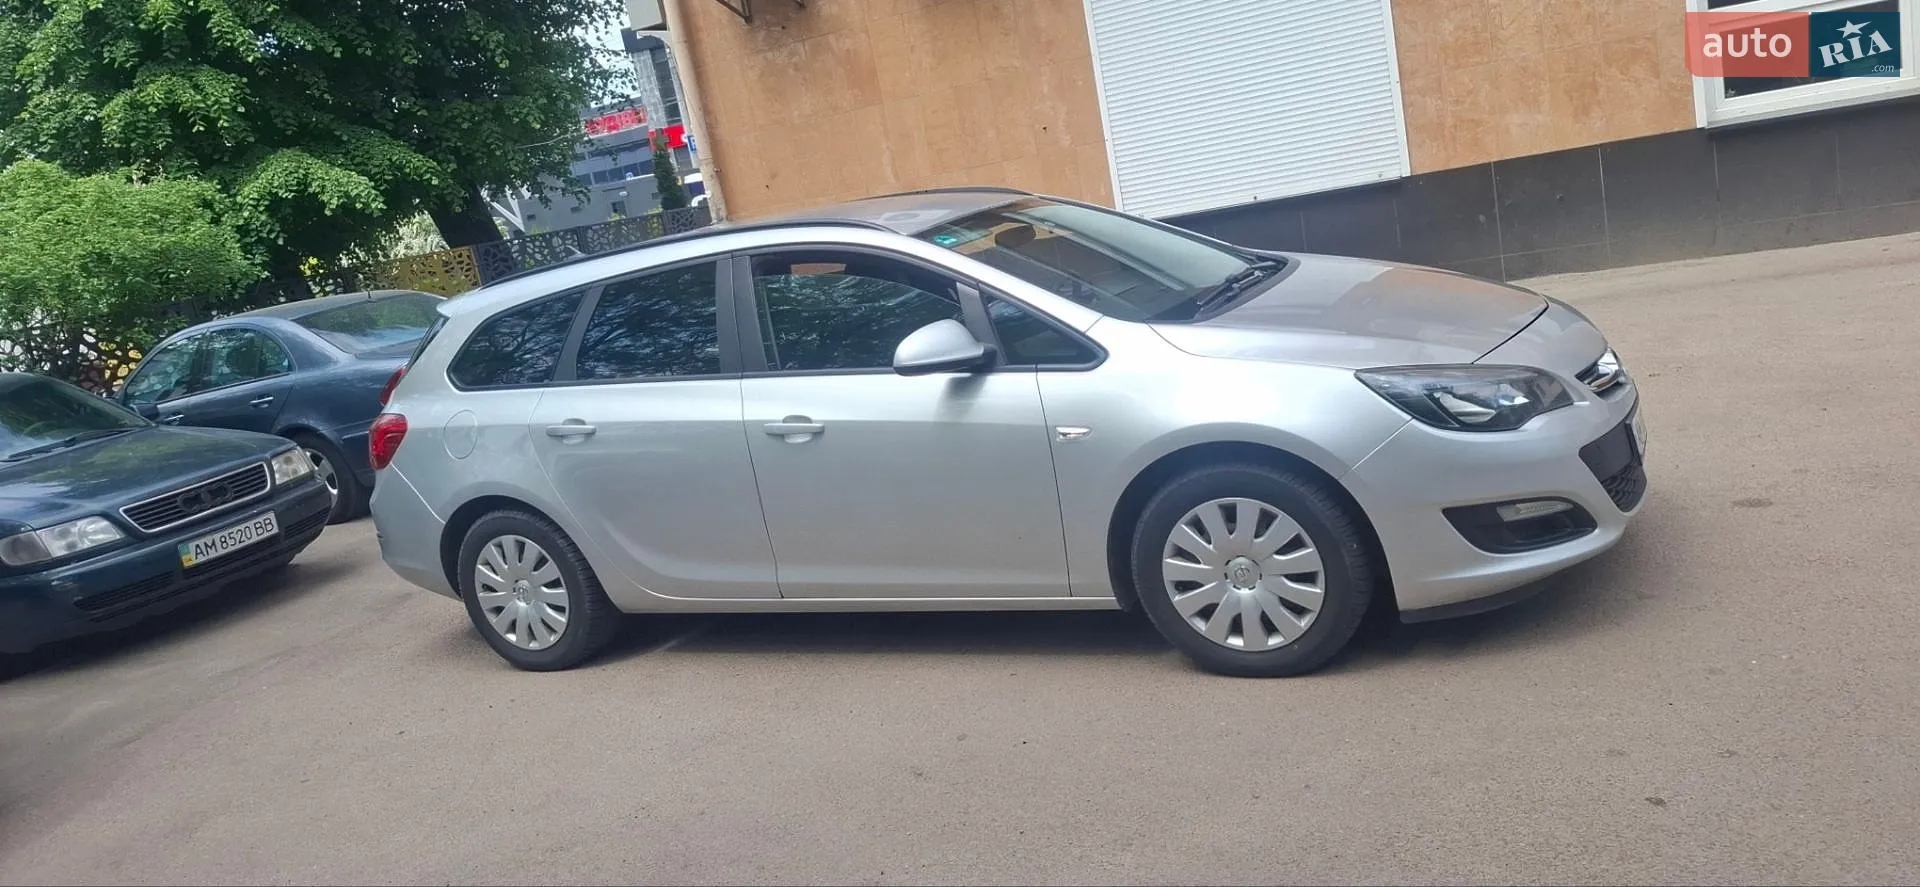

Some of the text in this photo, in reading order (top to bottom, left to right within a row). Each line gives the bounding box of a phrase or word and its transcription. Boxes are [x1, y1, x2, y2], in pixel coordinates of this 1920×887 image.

[194, 518, 274, 560] AM 8520 BB
